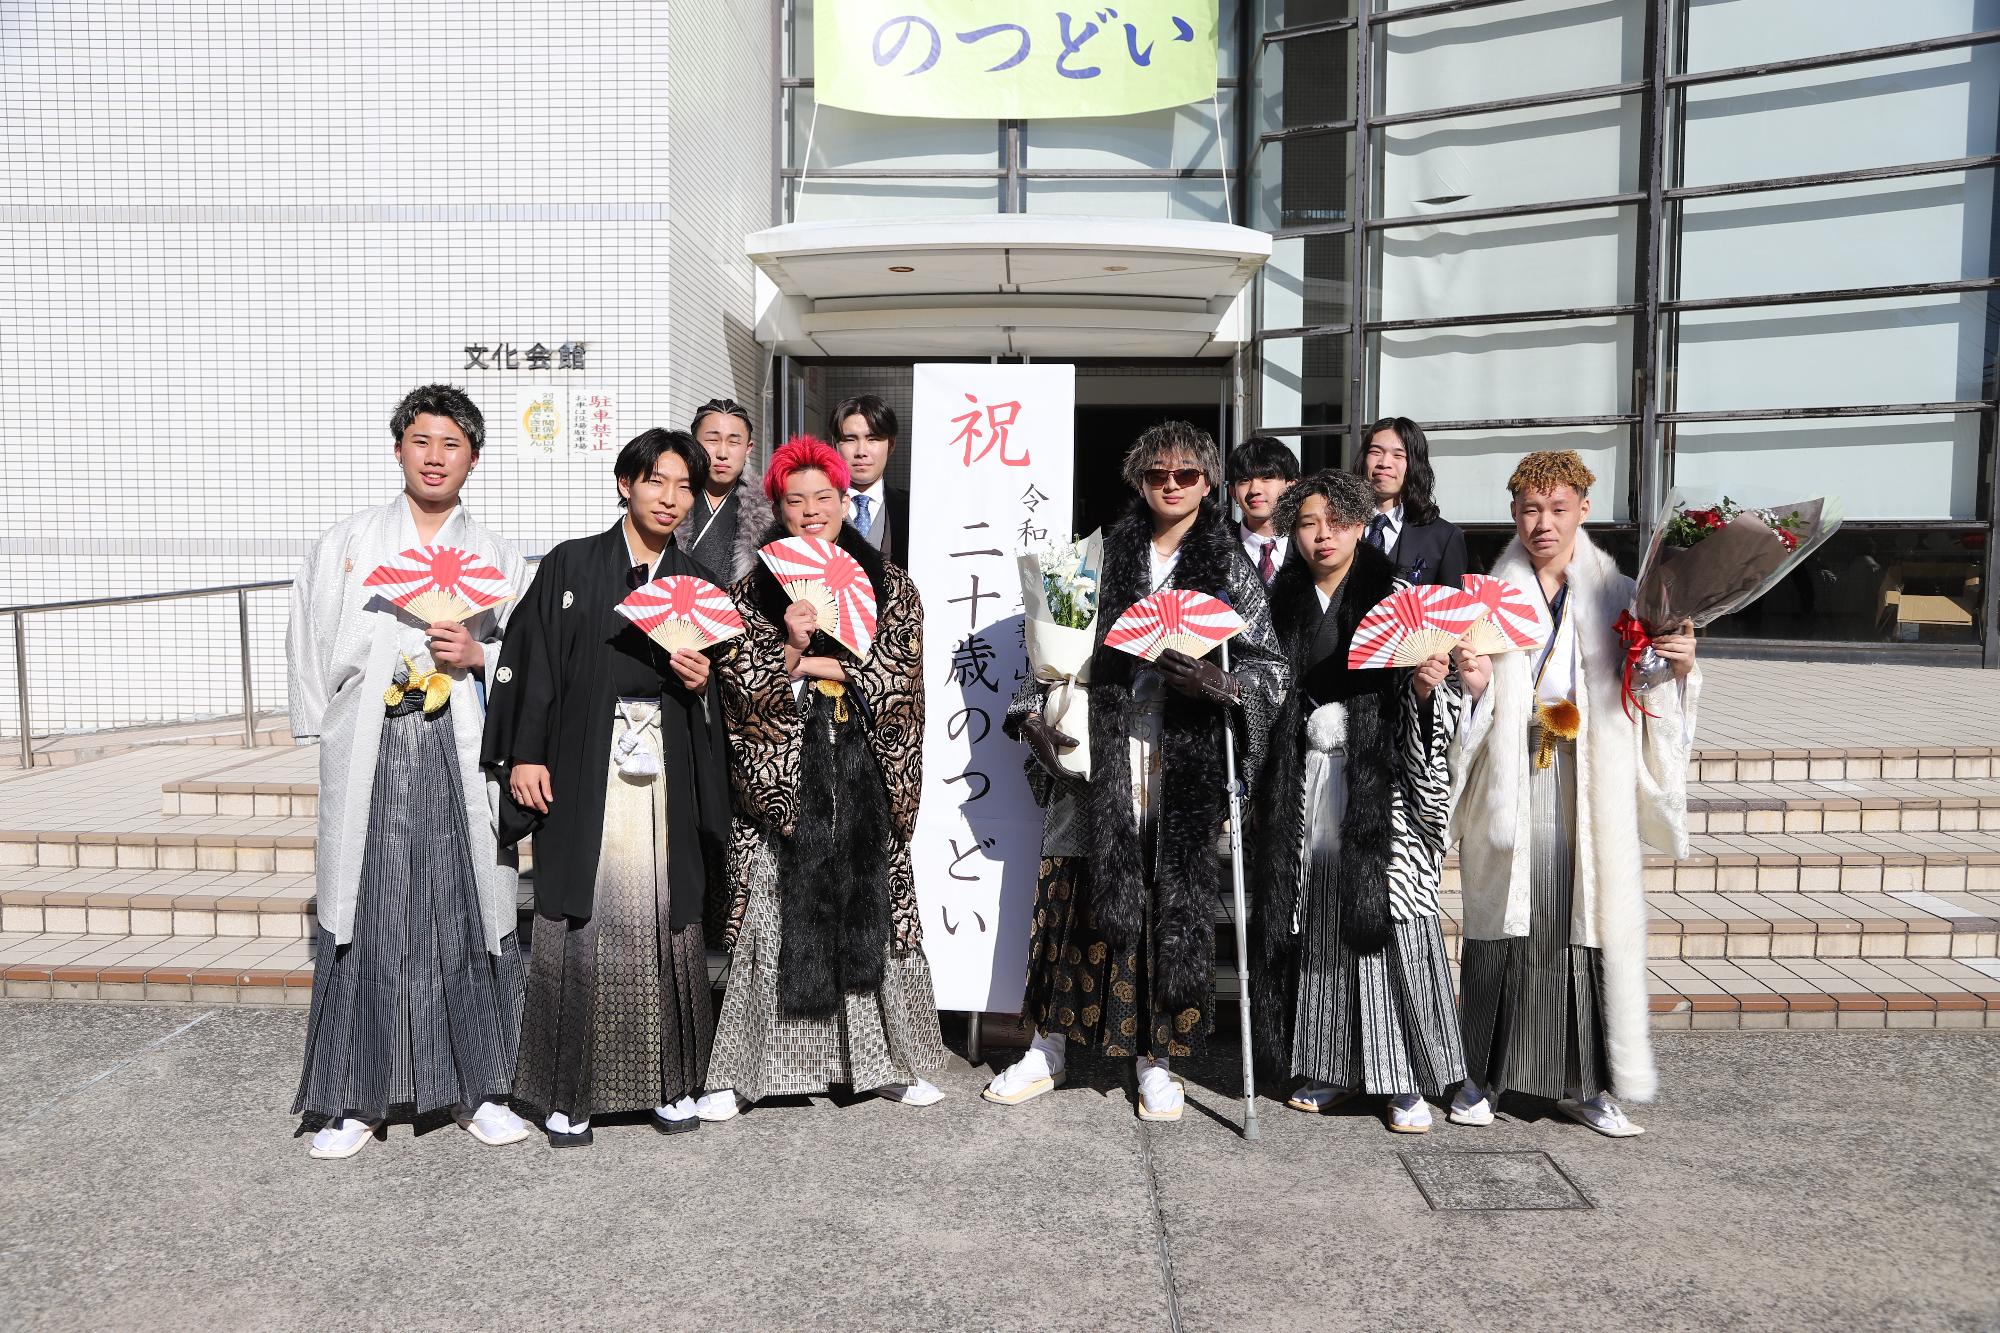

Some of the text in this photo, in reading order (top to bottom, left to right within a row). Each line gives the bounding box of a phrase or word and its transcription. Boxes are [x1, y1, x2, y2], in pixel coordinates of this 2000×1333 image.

[872, 8, 1194, 80] のつどい
[464, 342, 586, 370] 文化会館
[589, 395, 613, 451] 駐車禁止
[949, 393, 1031, 468] 祝
[942, 521, 1004, 936] 二十歳のつどい
